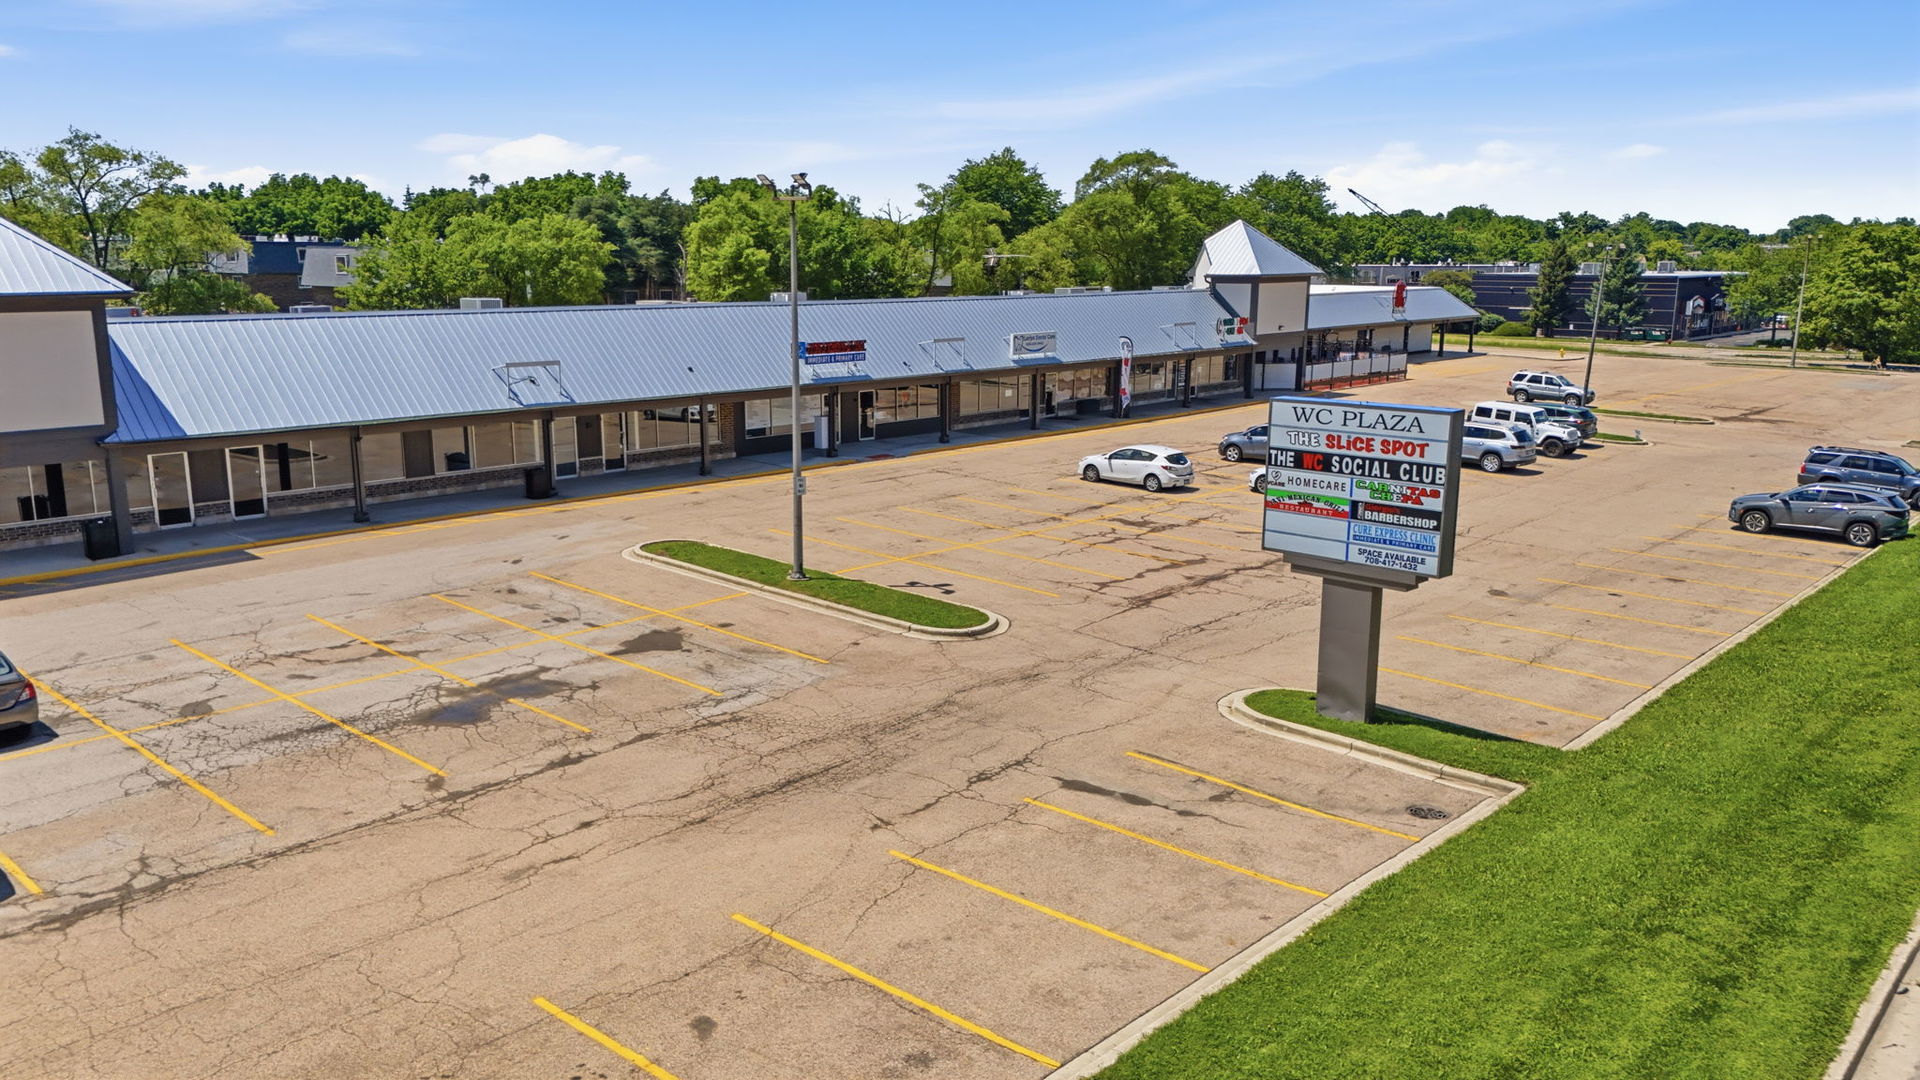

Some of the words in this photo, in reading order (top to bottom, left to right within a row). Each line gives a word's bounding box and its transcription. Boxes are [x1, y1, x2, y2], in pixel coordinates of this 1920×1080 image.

[1292, 406, 1333, 425] WC
[1342, 411, 1425, 433] PLAZA
[1286, 431, 1320, 447] THE
[1379, 439, 1429, 458] SPOT
[1270, 450, 1295, 467] THE
[1302, 453, 1324, 470] WC
[1331, 455, 1391, 478] SOCIAL
[1400, 464, 1446, 484] CLUB
[1287, 476, 1347, 492] HOMECARE
[1355, 479, 1441, 499] CARNITAS
[1288, 494, 1320, 503] MEXICAN
[1279, 504, 1334, 516] RESTAURANT
[1365, 511, 1437, 529] BARBERSHOP
[1353, 524, 1372, 535] CURE
[1374, 527, 1408, 541] EXPRESS
[1410, 532, 1436, 545] CLINIC
[1353, 535, 1384, 544] IMMEDIATE
[1420, 544, 1435, 552] CARE
[1358, 548, 1383, 559] SPACE
[1384, 552, 1426, 565] AVAILABLE
[1364, 556, 1418, 571] 708-417-1432
